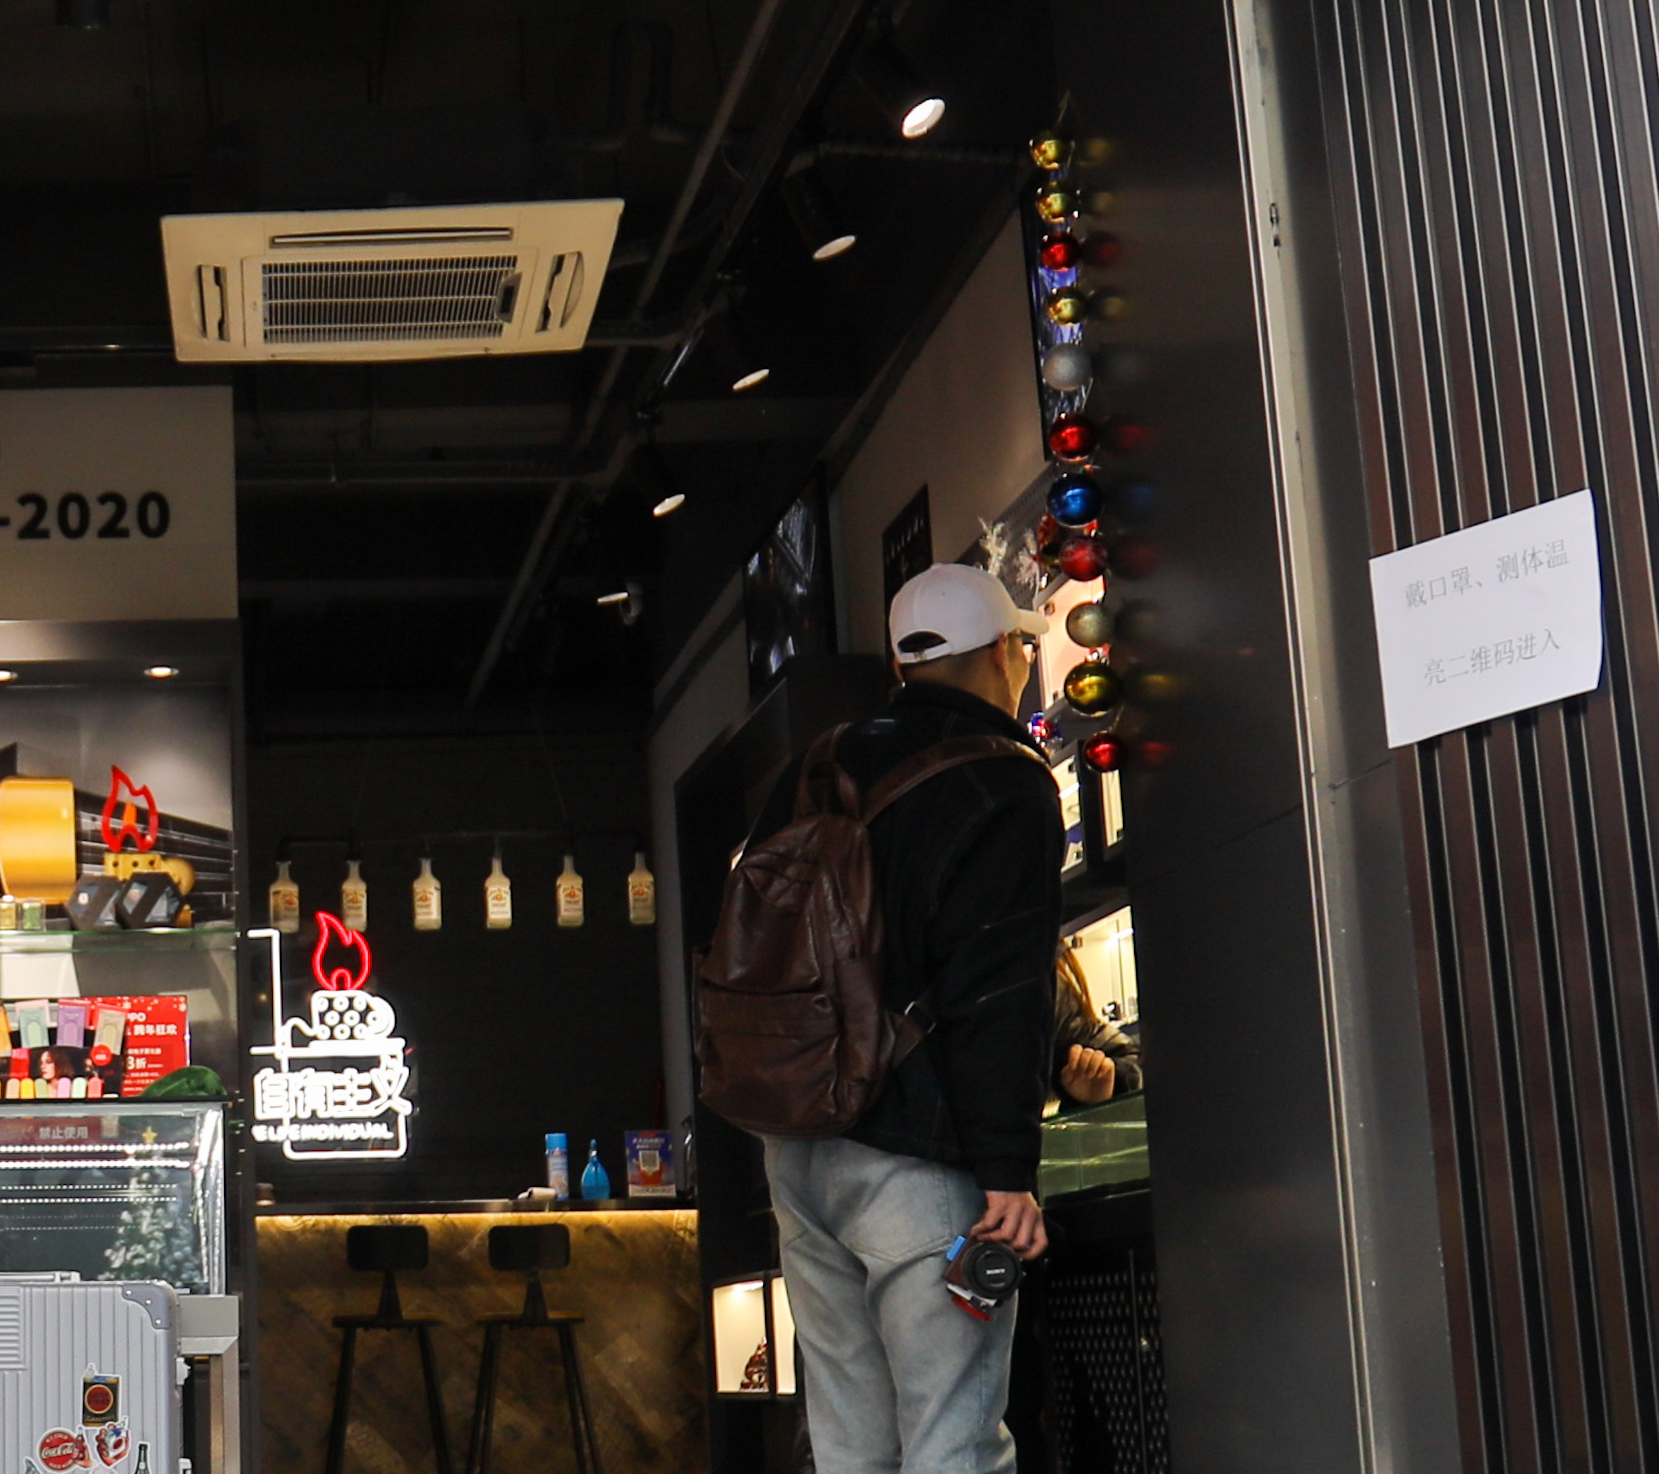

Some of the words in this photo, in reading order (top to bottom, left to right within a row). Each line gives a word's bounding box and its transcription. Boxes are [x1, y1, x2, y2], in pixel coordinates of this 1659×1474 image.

[1404, 538, 1570, 610] 戴口罩、测体温
[1422, 627, 1561, 687] 亮二维码进入
